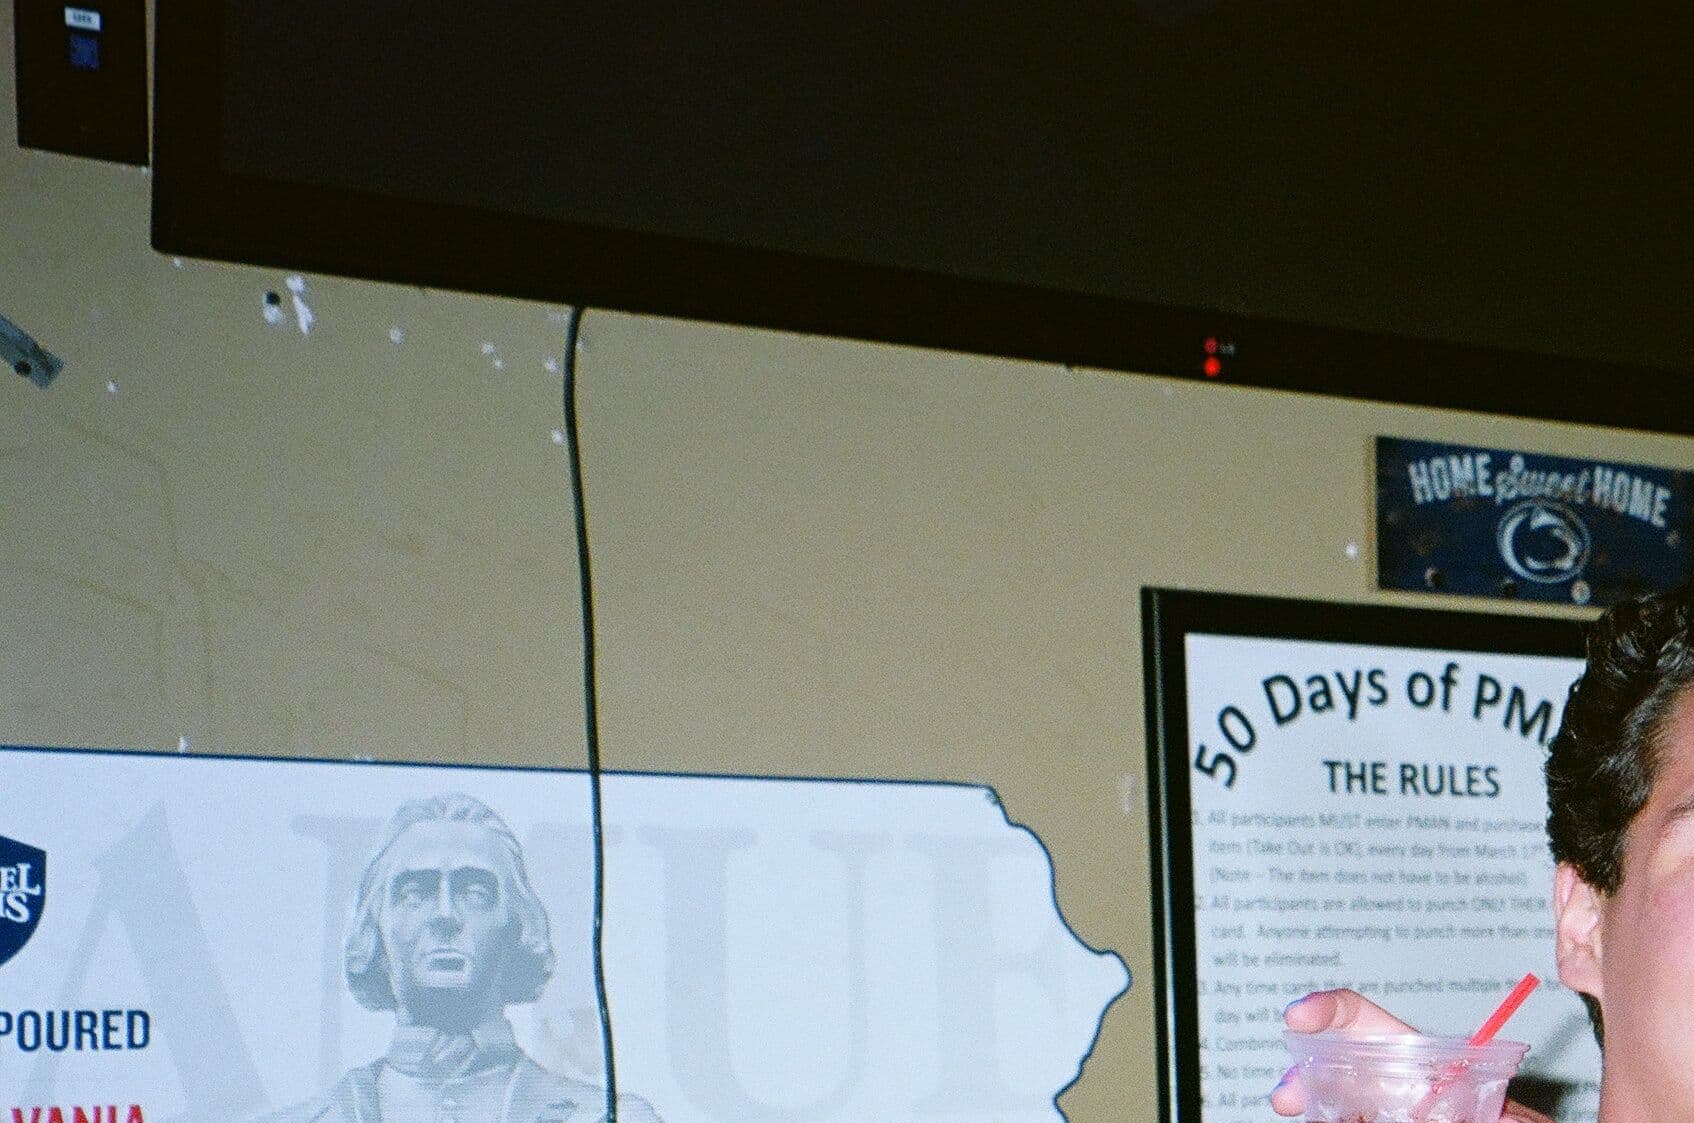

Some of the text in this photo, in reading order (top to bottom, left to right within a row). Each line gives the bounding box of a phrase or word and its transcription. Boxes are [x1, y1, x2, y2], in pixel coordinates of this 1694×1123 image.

[1408, 453, 1494, 505] HOME
[1592, 464, 1672, 528] HOME
[1196, 705, 1257, 789] 50
[1262, 667, 1388, 726] Days
[1406, 661, 1460, 711] of
[1323, 760, 1500, 798] THE RULES
[1230, 813, 1316, 829] participants
[1233, 898, 1319, 914] participants
